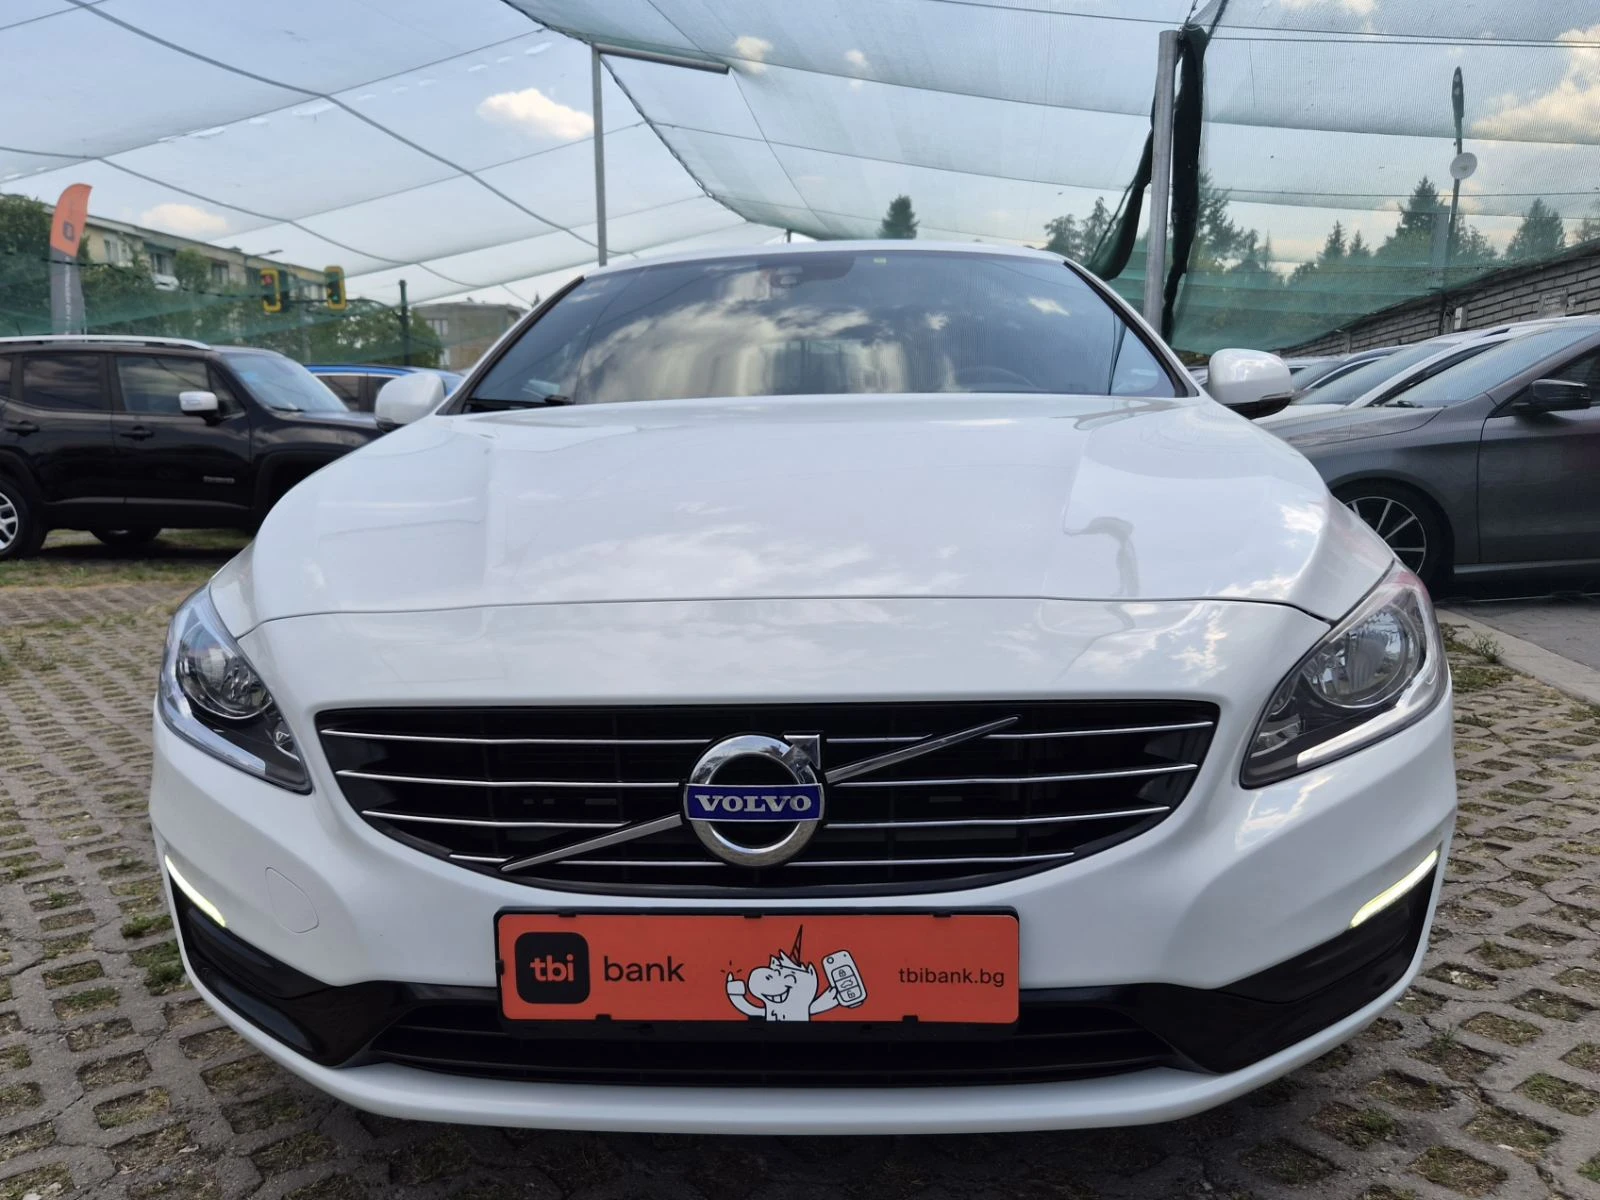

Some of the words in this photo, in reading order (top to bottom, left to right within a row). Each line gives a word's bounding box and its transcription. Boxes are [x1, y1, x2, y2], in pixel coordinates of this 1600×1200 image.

[695, 794, 811, 812] VOLVO
[530, 954, 575, 982] tbi
[604, 955, 685, 982] bank
[898, 967, 1005, 987] tbibank.bg
